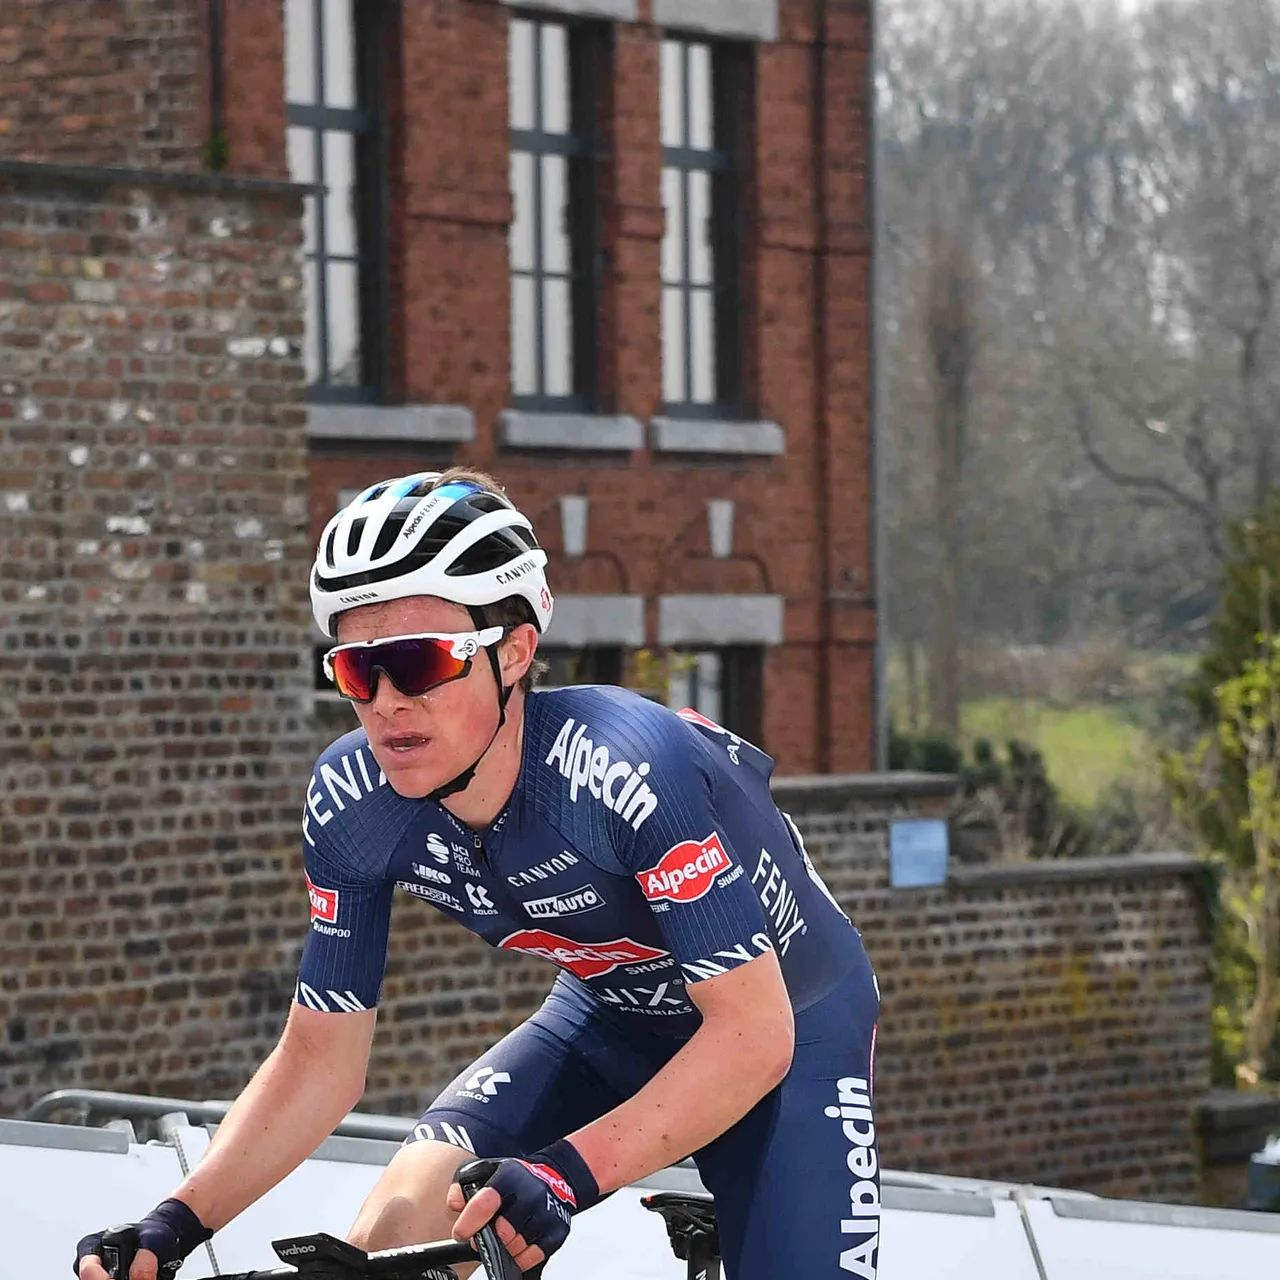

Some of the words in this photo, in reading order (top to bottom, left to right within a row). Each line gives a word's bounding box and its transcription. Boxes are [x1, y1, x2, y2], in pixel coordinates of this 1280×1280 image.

[495, 558, 537, 586] CANYON
[339, 591, 379, 604] CANYON
[545, 717, 659, 832] Alpecin
[450, 841, 470, 857] UCI
[451, 851, 473, 867] PRO
[454, 862, 481, 879] TEAM
[507, 850, 580, 888] CANYON
[646, 847, 724, 895] Alpecin
[619, 1005, 694, 1017] MATERIALS
[278, 1244, 317, 1257] wahoo
